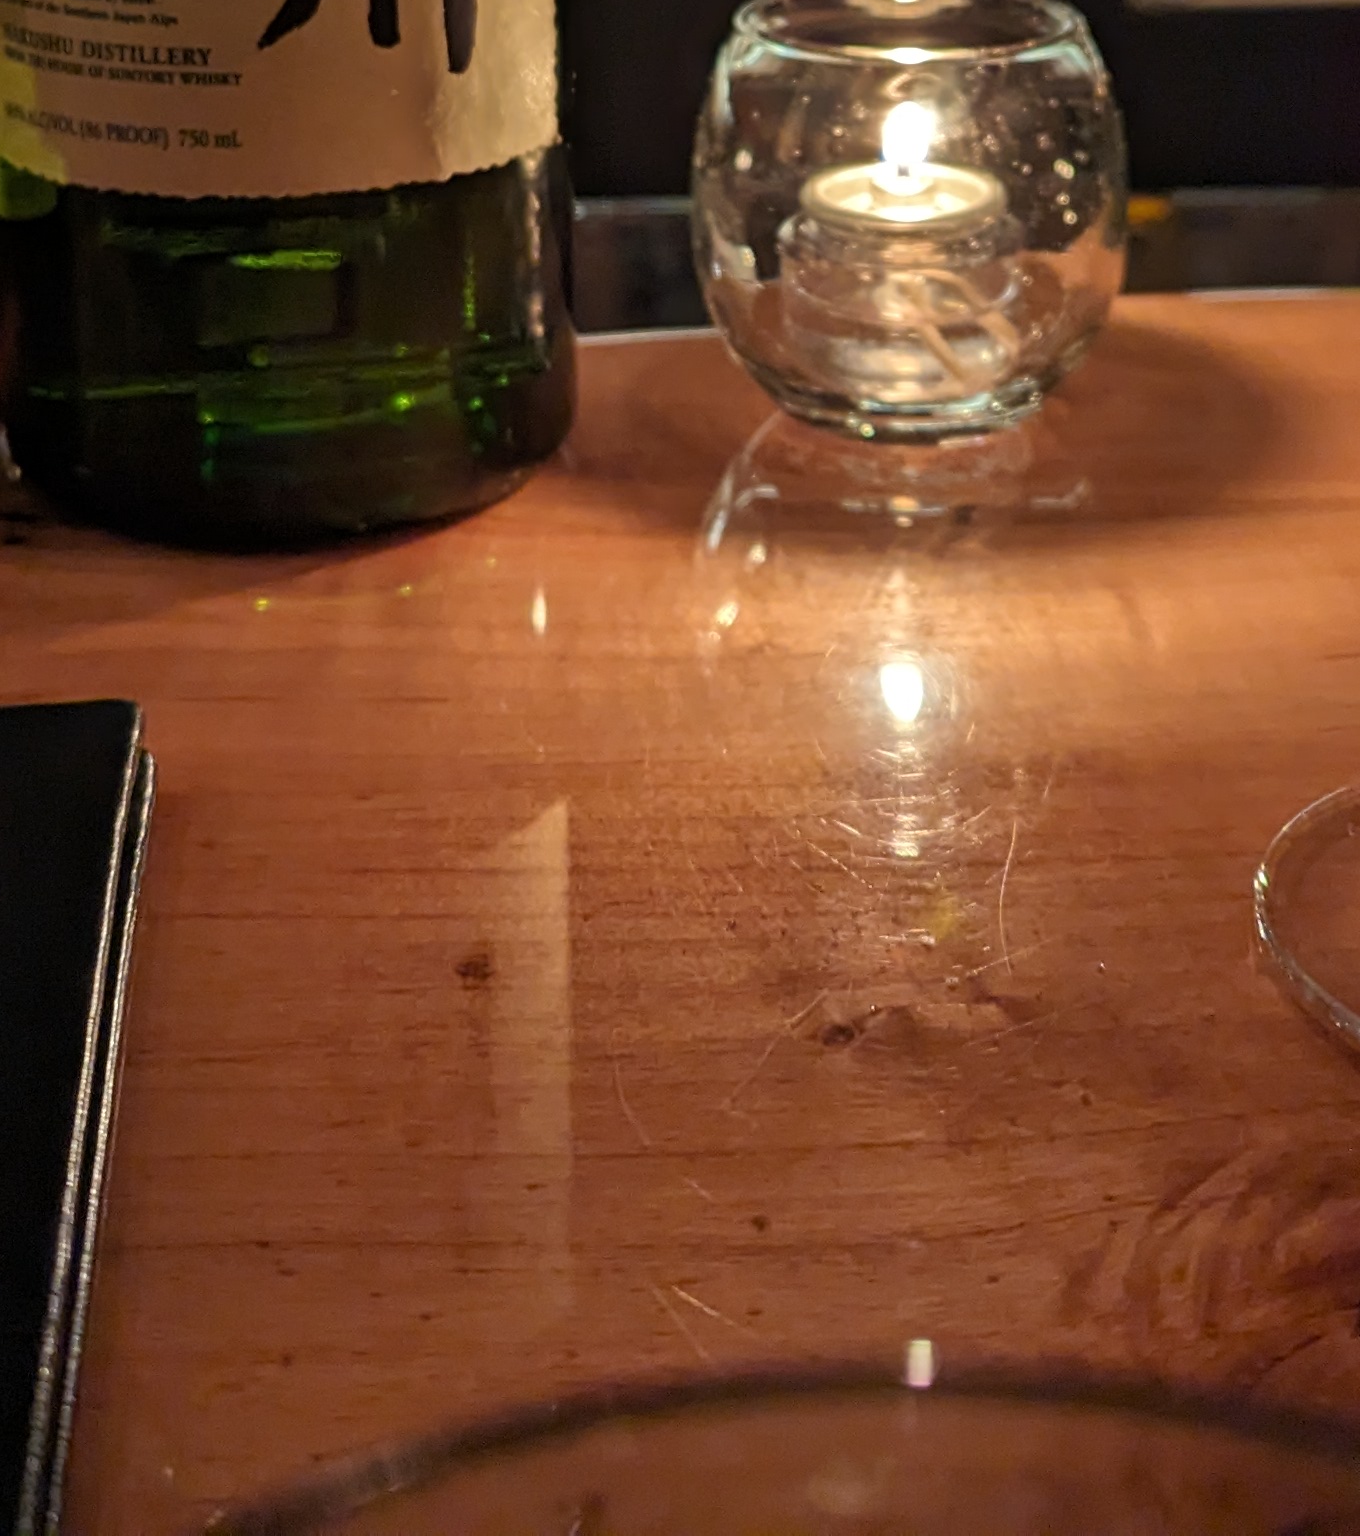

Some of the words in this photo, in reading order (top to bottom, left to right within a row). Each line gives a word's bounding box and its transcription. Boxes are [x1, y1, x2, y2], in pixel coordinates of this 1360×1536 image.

[81, 39, 211, 67] DISTILLERY
[180, 70, 243, 86] WHISKY
[106, 121, 170, 150] PROOF)
[178, 128, 209, 147] 750
[214, 130, 243, 148] mL
